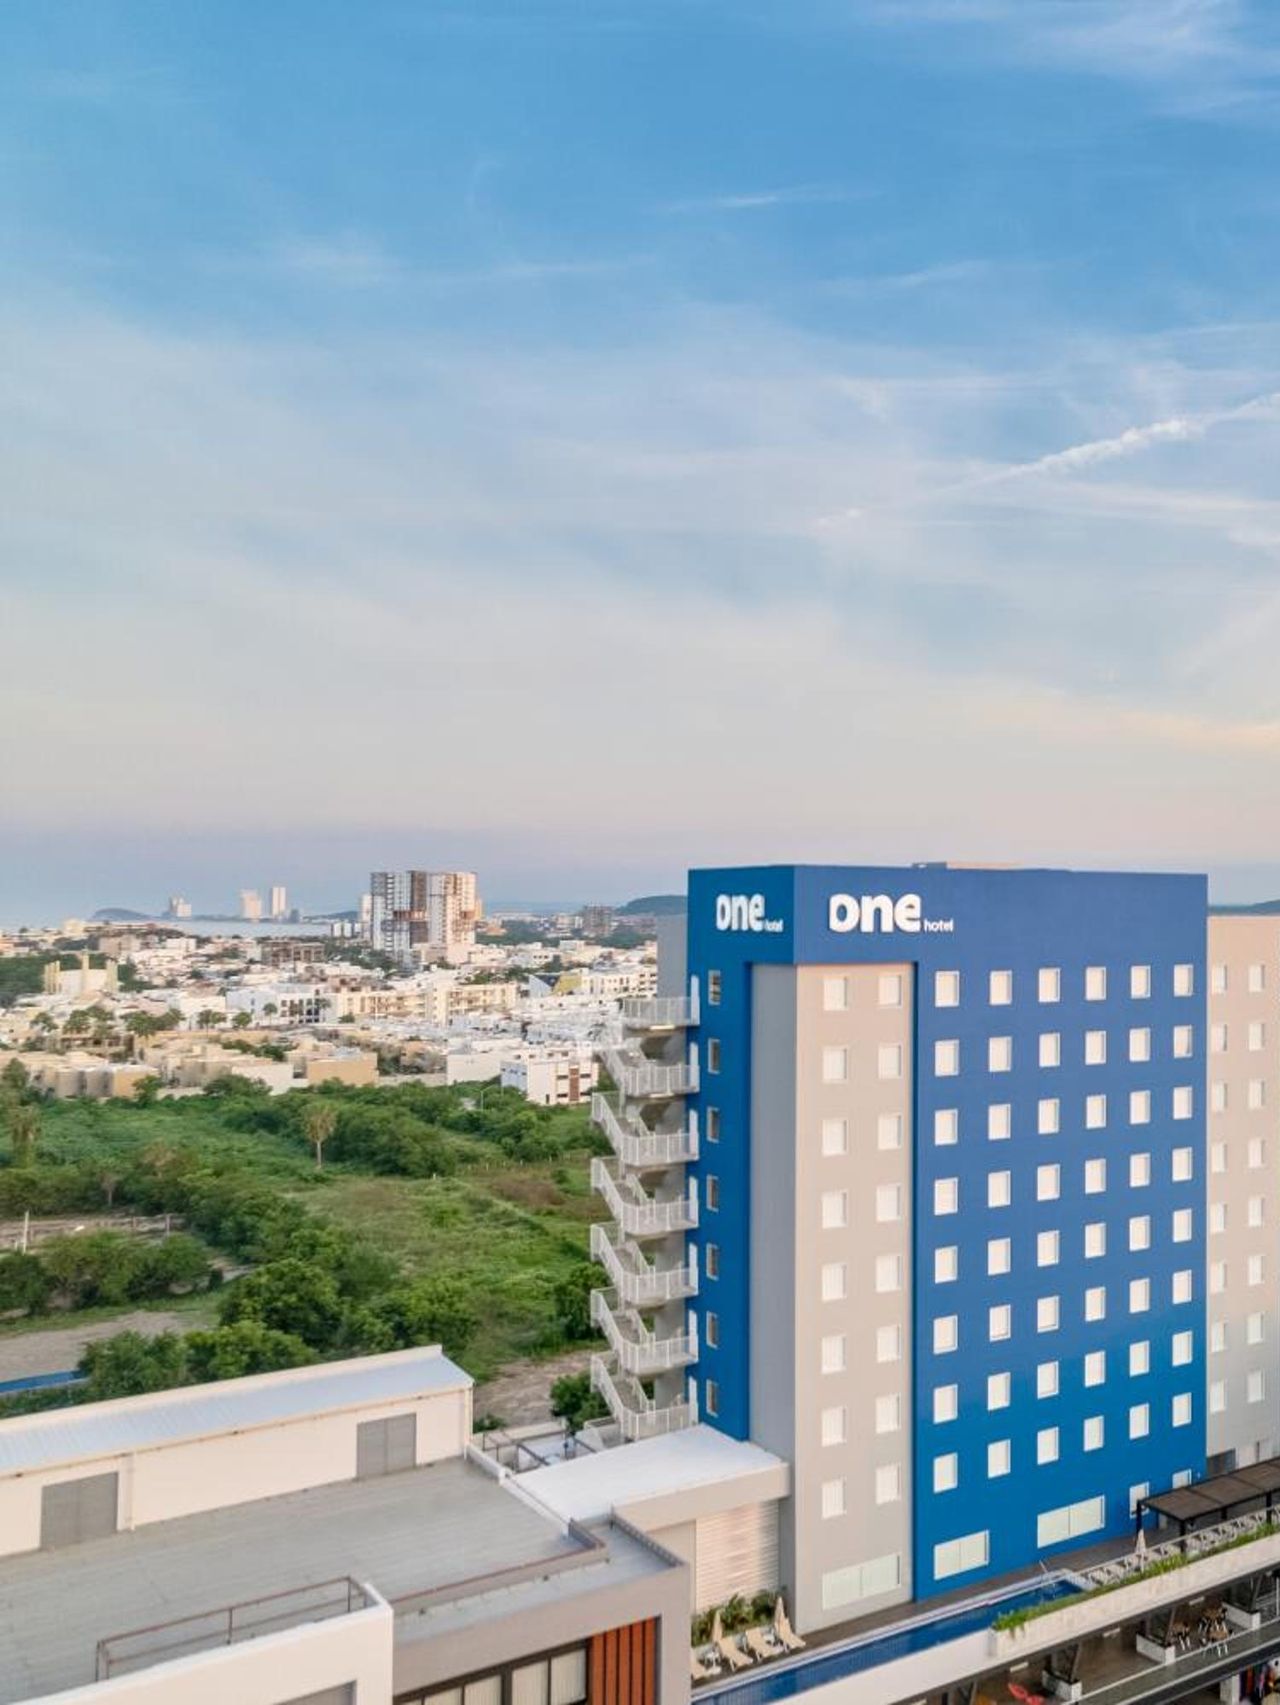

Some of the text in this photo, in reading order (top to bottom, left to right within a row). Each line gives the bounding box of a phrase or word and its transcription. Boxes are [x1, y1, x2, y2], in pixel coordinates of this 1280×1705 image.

[717, 894, 765, 932] one
[829, 893, 954, 933] one hotel
